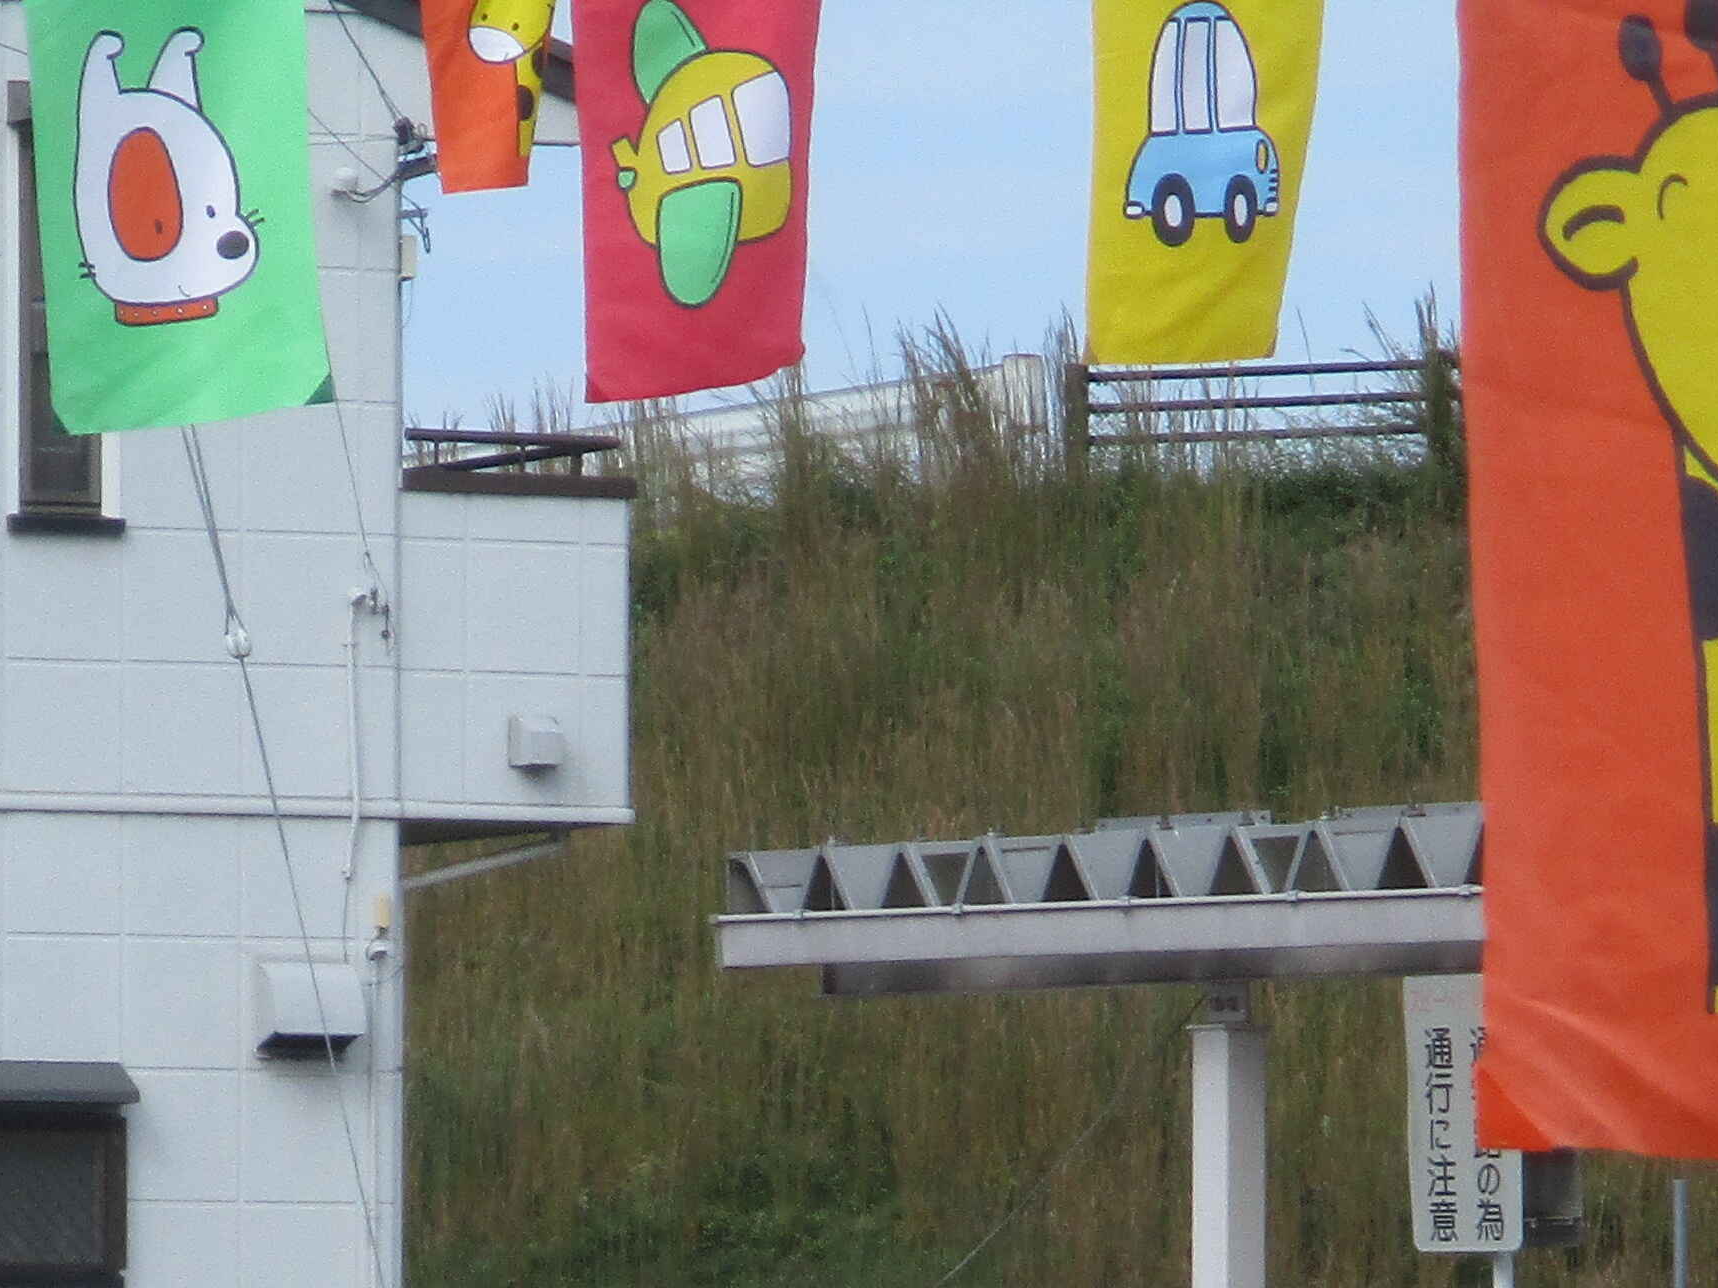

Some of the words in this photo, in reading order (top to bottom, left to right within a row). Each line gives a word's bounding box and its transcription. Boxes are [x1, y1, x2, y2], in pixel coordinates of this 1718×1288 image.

[1424, 1026, 1459, 1243] 通行に注意
